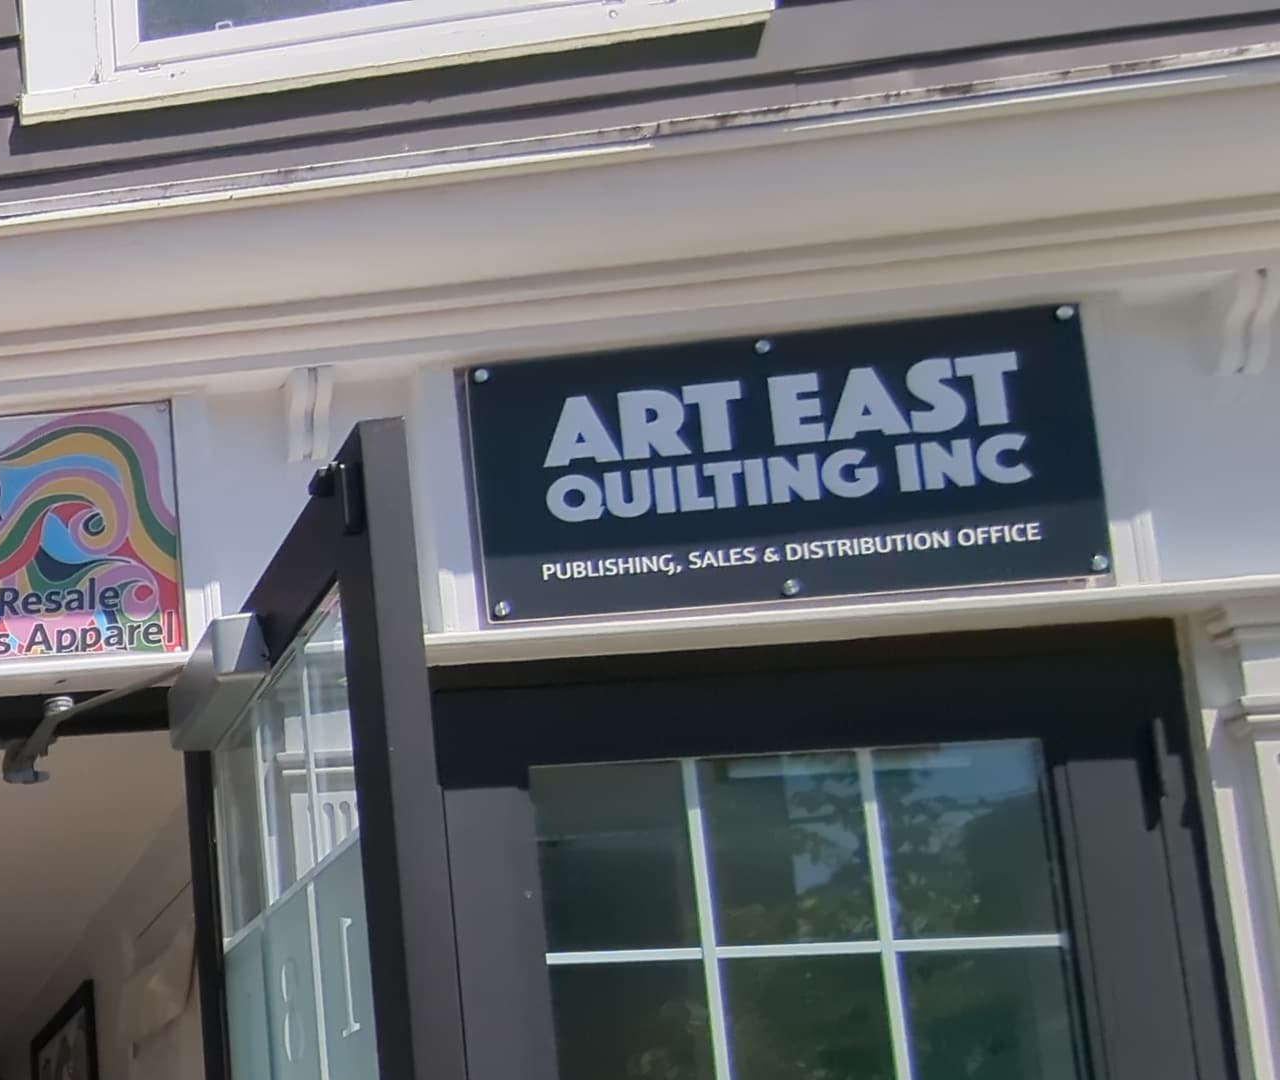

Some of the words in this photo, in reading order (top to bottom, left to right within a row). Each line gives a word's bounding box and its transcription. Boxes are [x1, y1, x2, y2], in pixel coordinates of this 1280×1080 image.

[543, 380, 742, 468] ART
[767, 351, 1019, 446] EAST
[545, 449, 880, 524] QUILTING
[897, 433, 1033, 493] INC
[542, 552, 683, 582] PUBLISHING,
[688, 545, 756, 570] SALES
[763, 545, 780, 563] &
[785, 531, 951, 562] DISTRIBUTION
[957, 522, 1042, 547] OFFICE
[24, 610, 175, 657] Apparel
